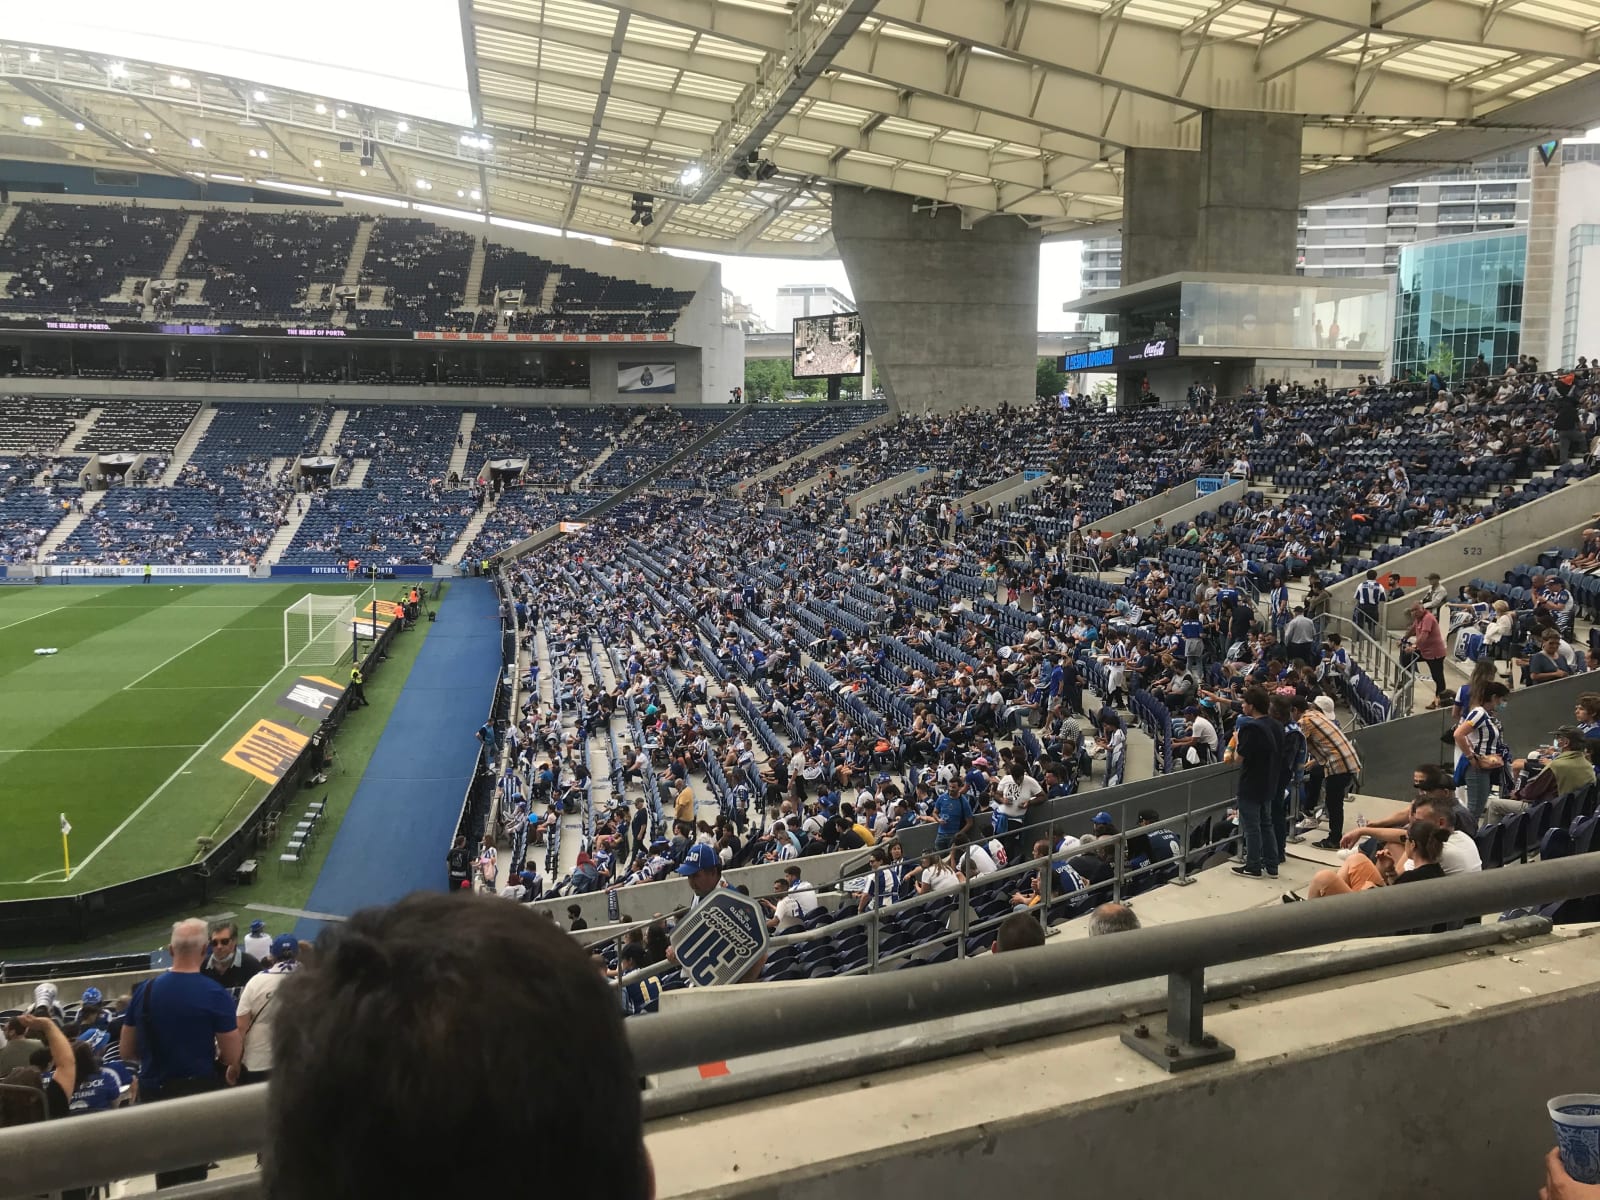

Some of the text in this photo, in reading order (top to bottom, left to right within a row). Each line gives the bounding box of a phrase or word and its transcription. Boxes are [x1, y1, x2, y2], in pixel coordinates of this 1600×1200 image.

[729, 905, 746, 924] PORTO
[701, 913, 750, 957] Campeão
[710, 908, 757, 949] Nacional
[743, 922, 753, 932] FC
[80, 1079, 105, 1090] OCK
